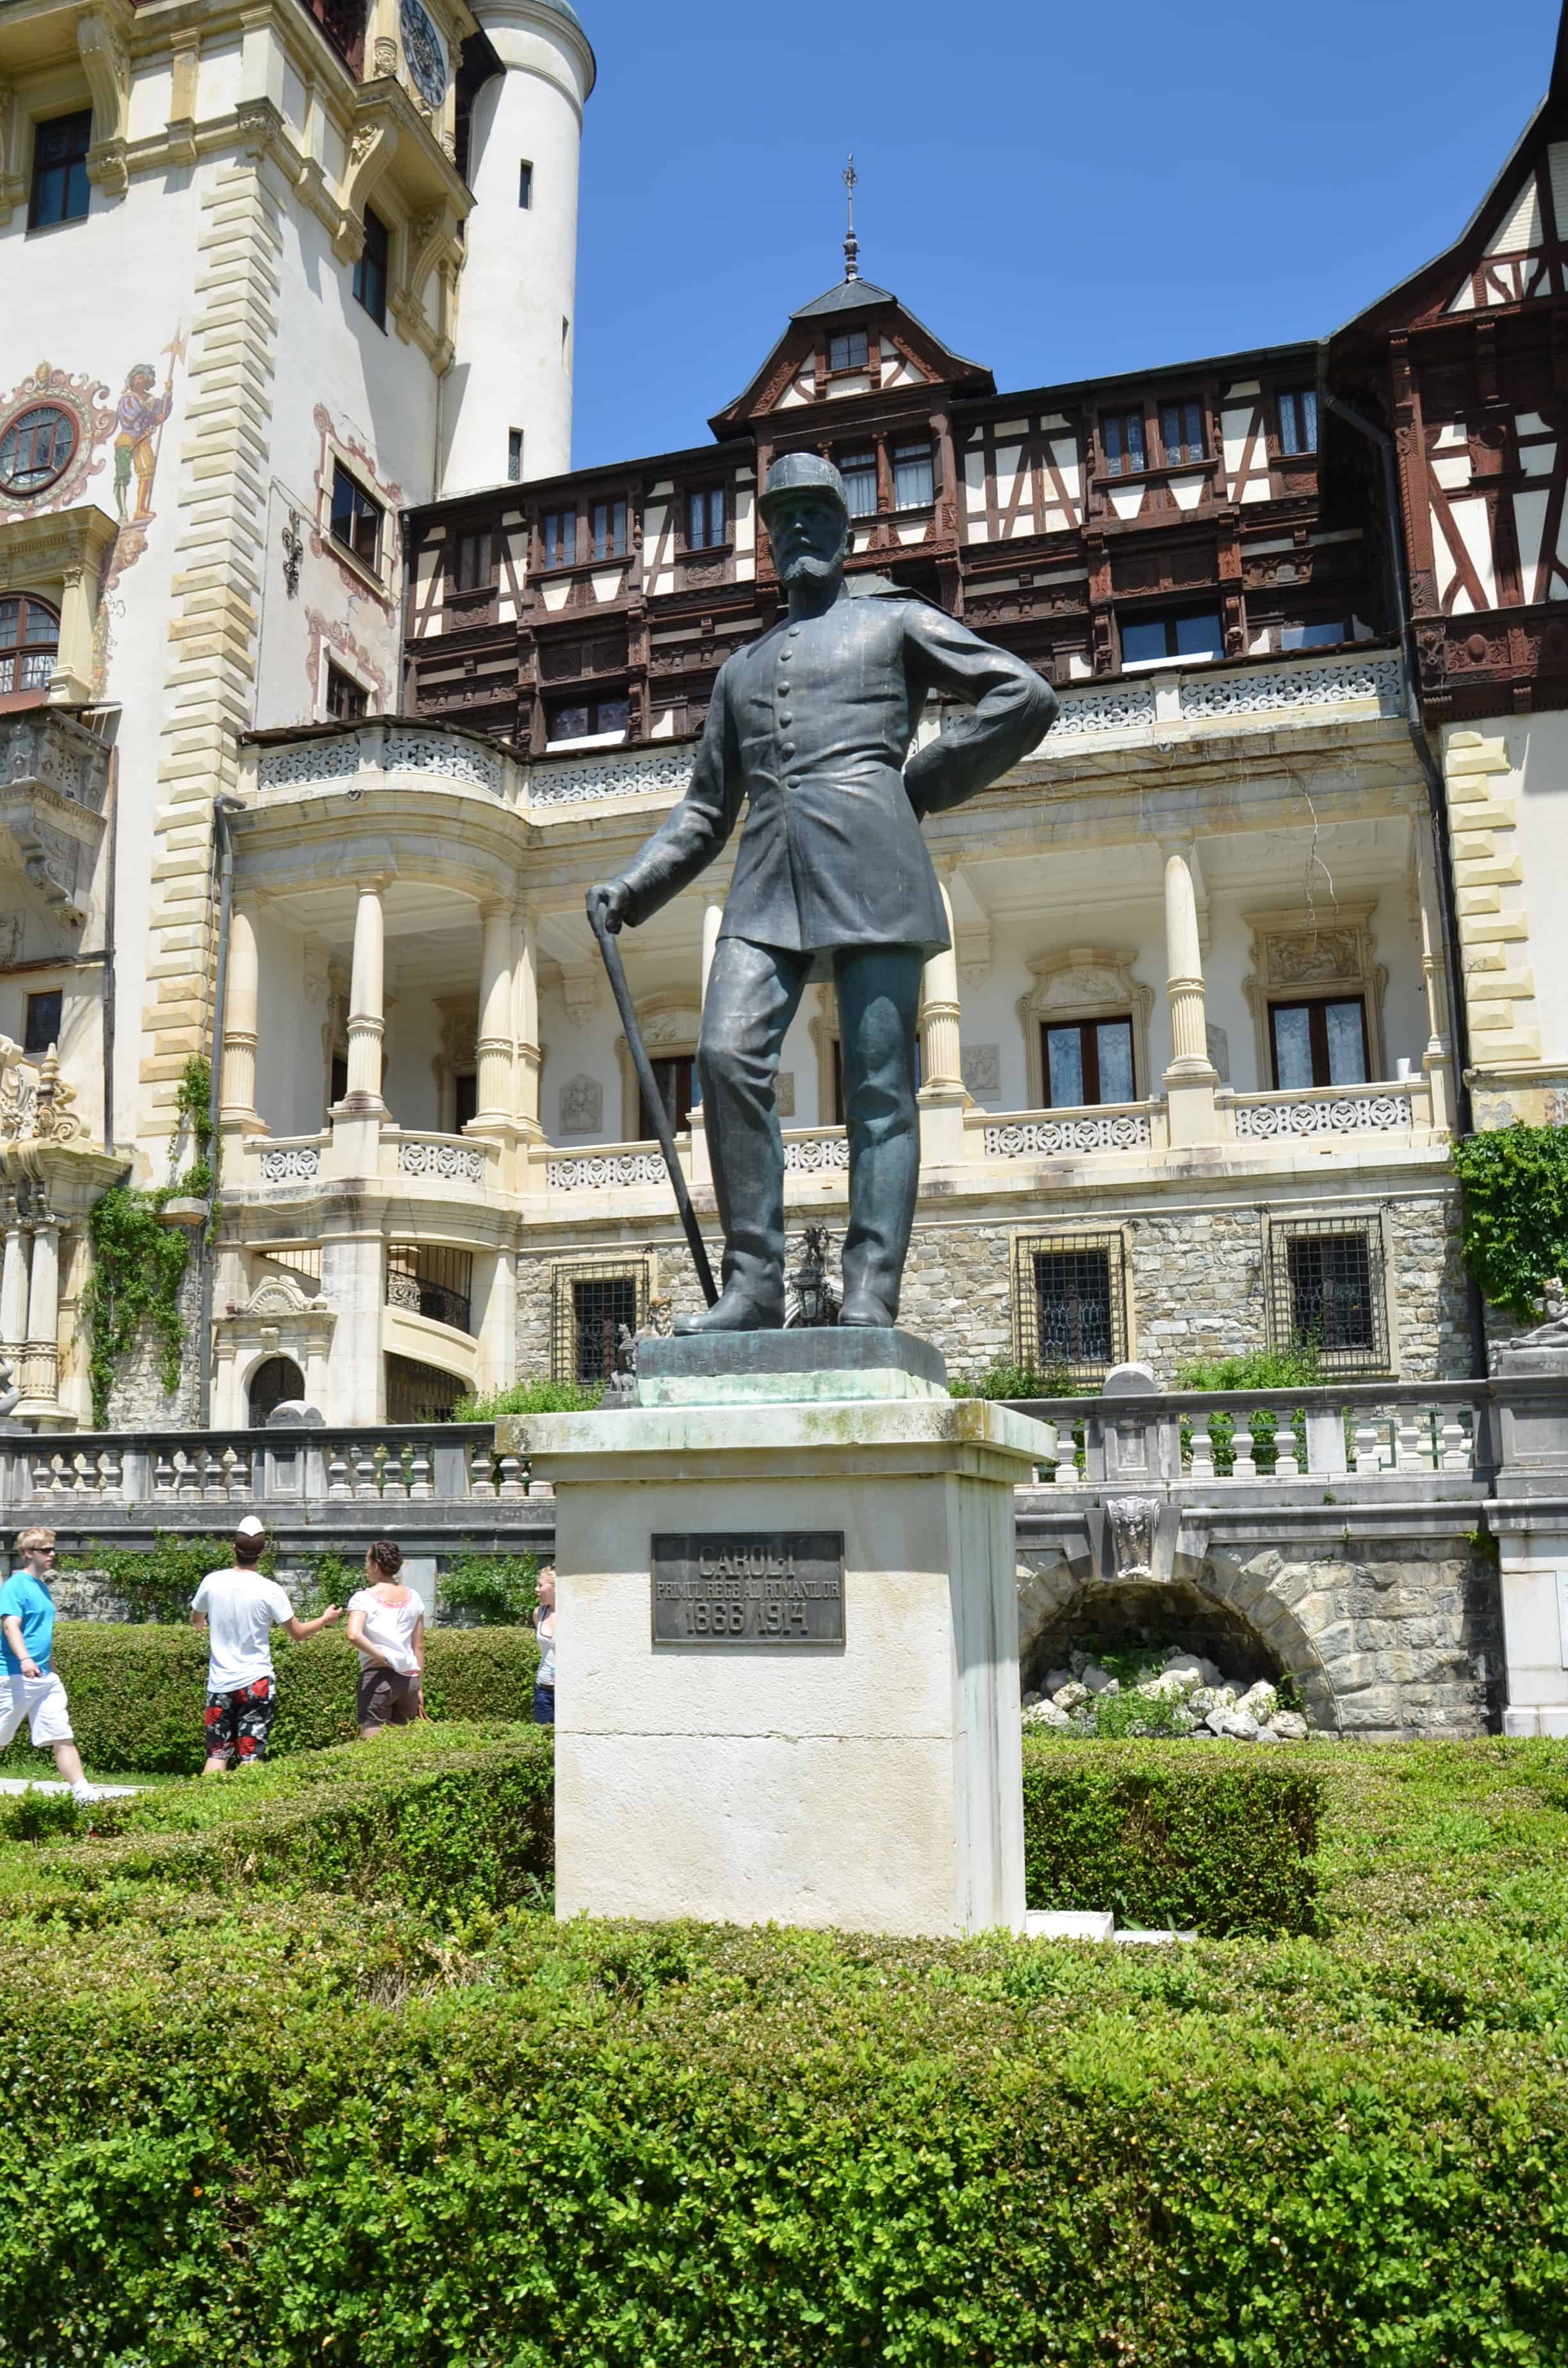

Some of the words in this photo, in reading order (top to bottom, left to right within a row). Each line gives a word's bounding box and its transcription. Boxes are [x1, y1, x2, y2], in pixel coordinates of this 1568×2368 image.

[656, 1581, 703, 1599] PRIMUL
[706, 1581, 740, 1599] REGE
[743, 1581, 760, 1599] AL
[686, 1602, 744, 1634] 1866
[758, 1602, 810, 1634] 1914
